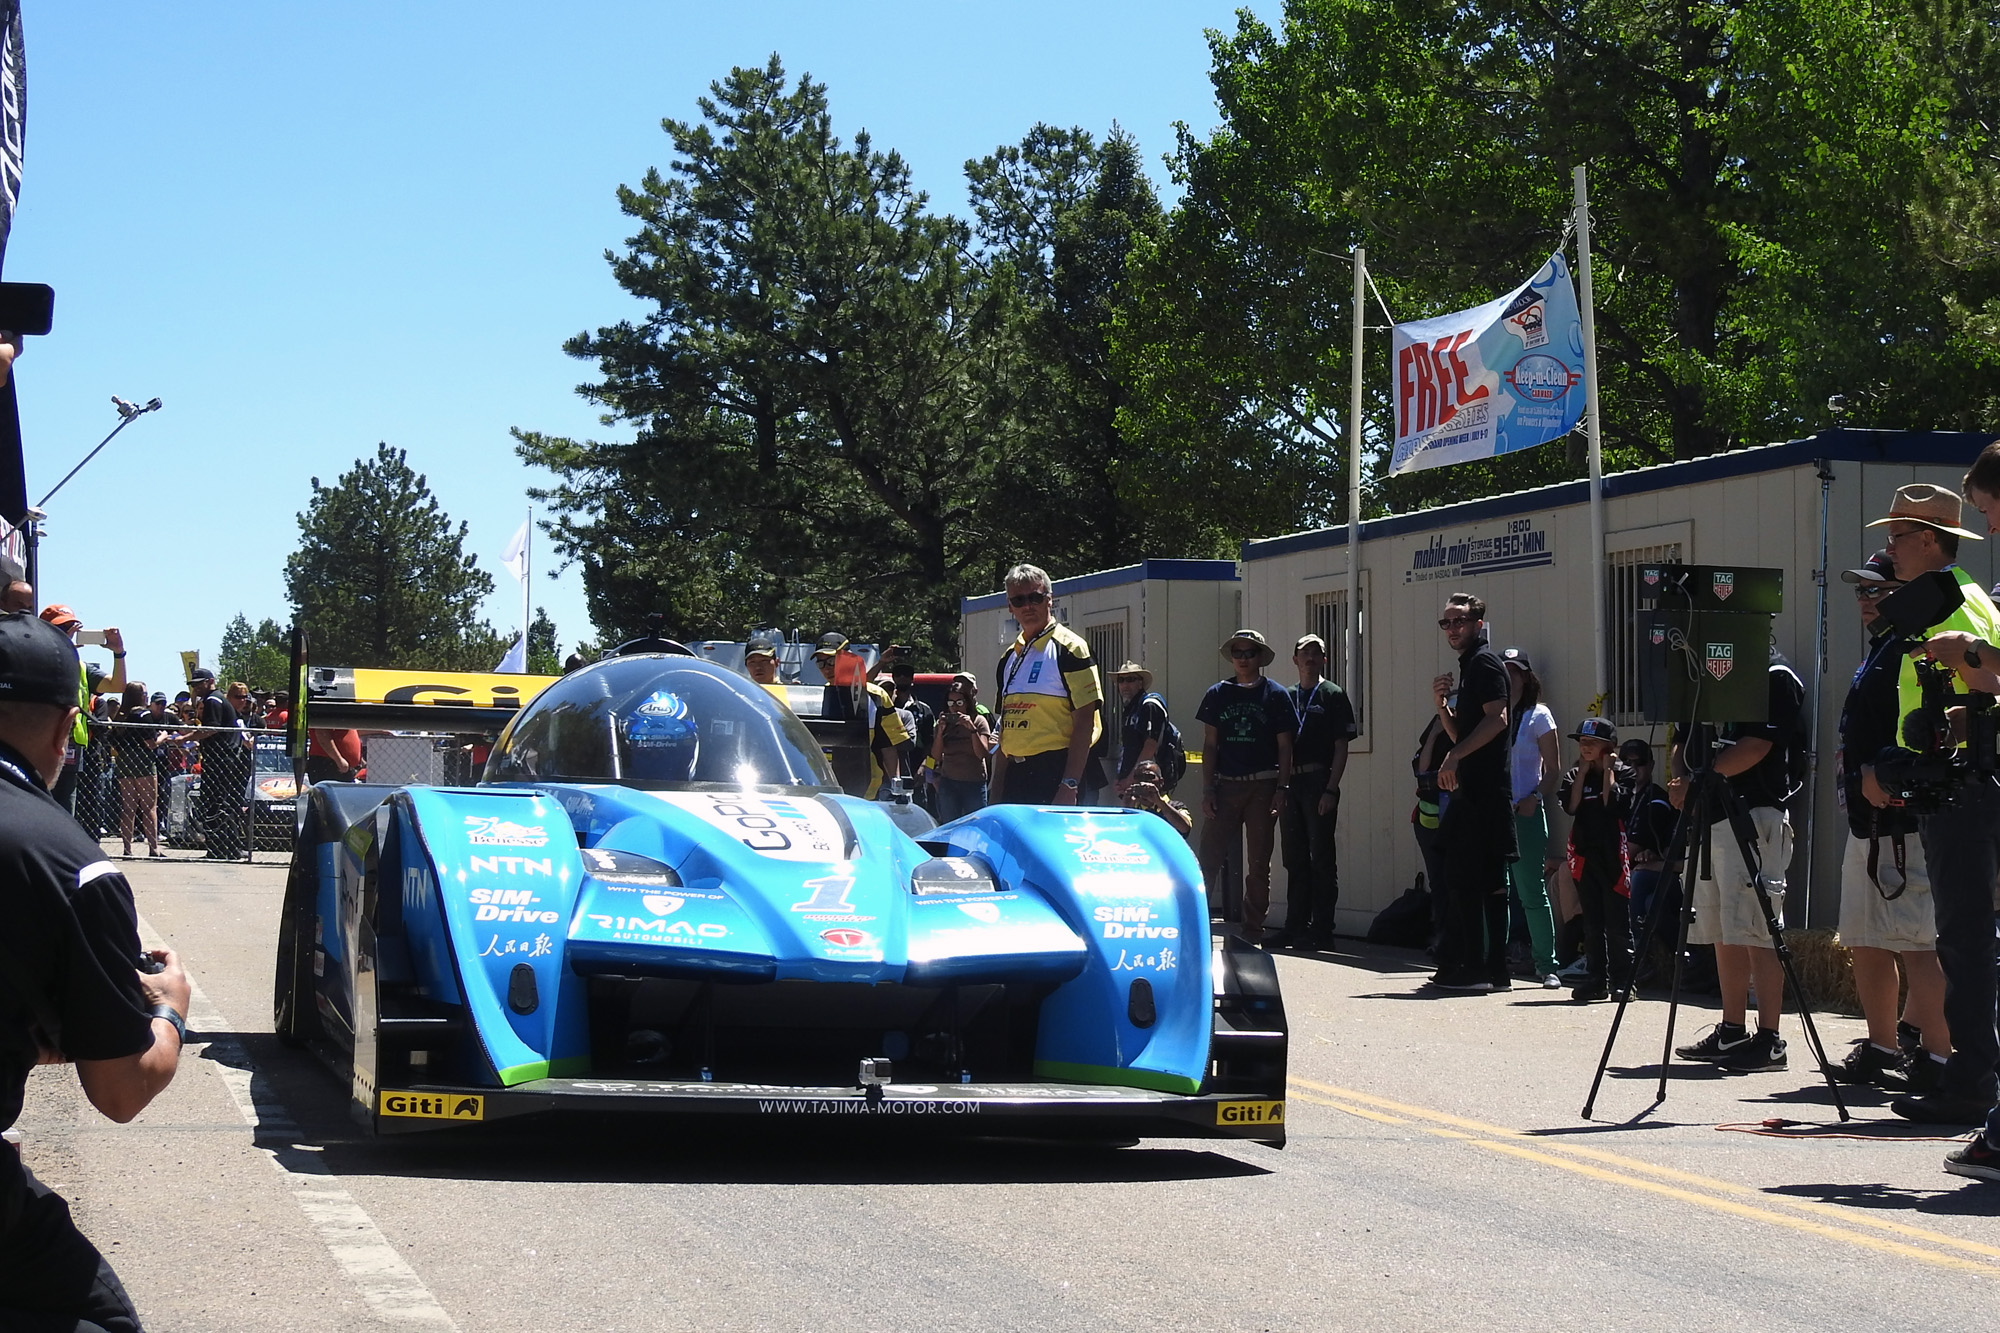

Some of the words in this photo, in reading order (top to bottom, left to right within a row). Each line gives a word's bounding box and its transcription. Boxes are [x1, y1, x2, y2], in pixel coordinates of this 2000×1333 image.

[1399, 329, 1490, 438] FREE
[1413, 534, 1446, 569] mobile
[1447, 537, 1471, 565] mini
[1471, 538, 1493, 550] STORAGE
[1471, 550, 1493, 561] SYSTEMS
[1715, 574, 1732, 583] TAG
[1708, 645, 1731, 658] TAG
[1707, 660, 1731, 678] HEUER
[470, 855, 552, 876] NTN
[402, 867, 427, 910] NTN
[607, 885, 636, 893] WITH
[640, 888, 661, 896] THE
[664, 891, 705, 899] POWER
[790, 875, 856, 913] 1
[966, 895, 1004, 903] POWER
[474, 906, 560, 924] Drive
[613, 932, 703, 945] AUTOMOBILI
[1103, 922, 1179, 939] Drive
[386, 1096, 442, 1115] Giti
[759, 1100, 981, 1114] WWW.TAJIMA-MOTOR.COM
[1221, 1105, 1262, 1122] Giti
